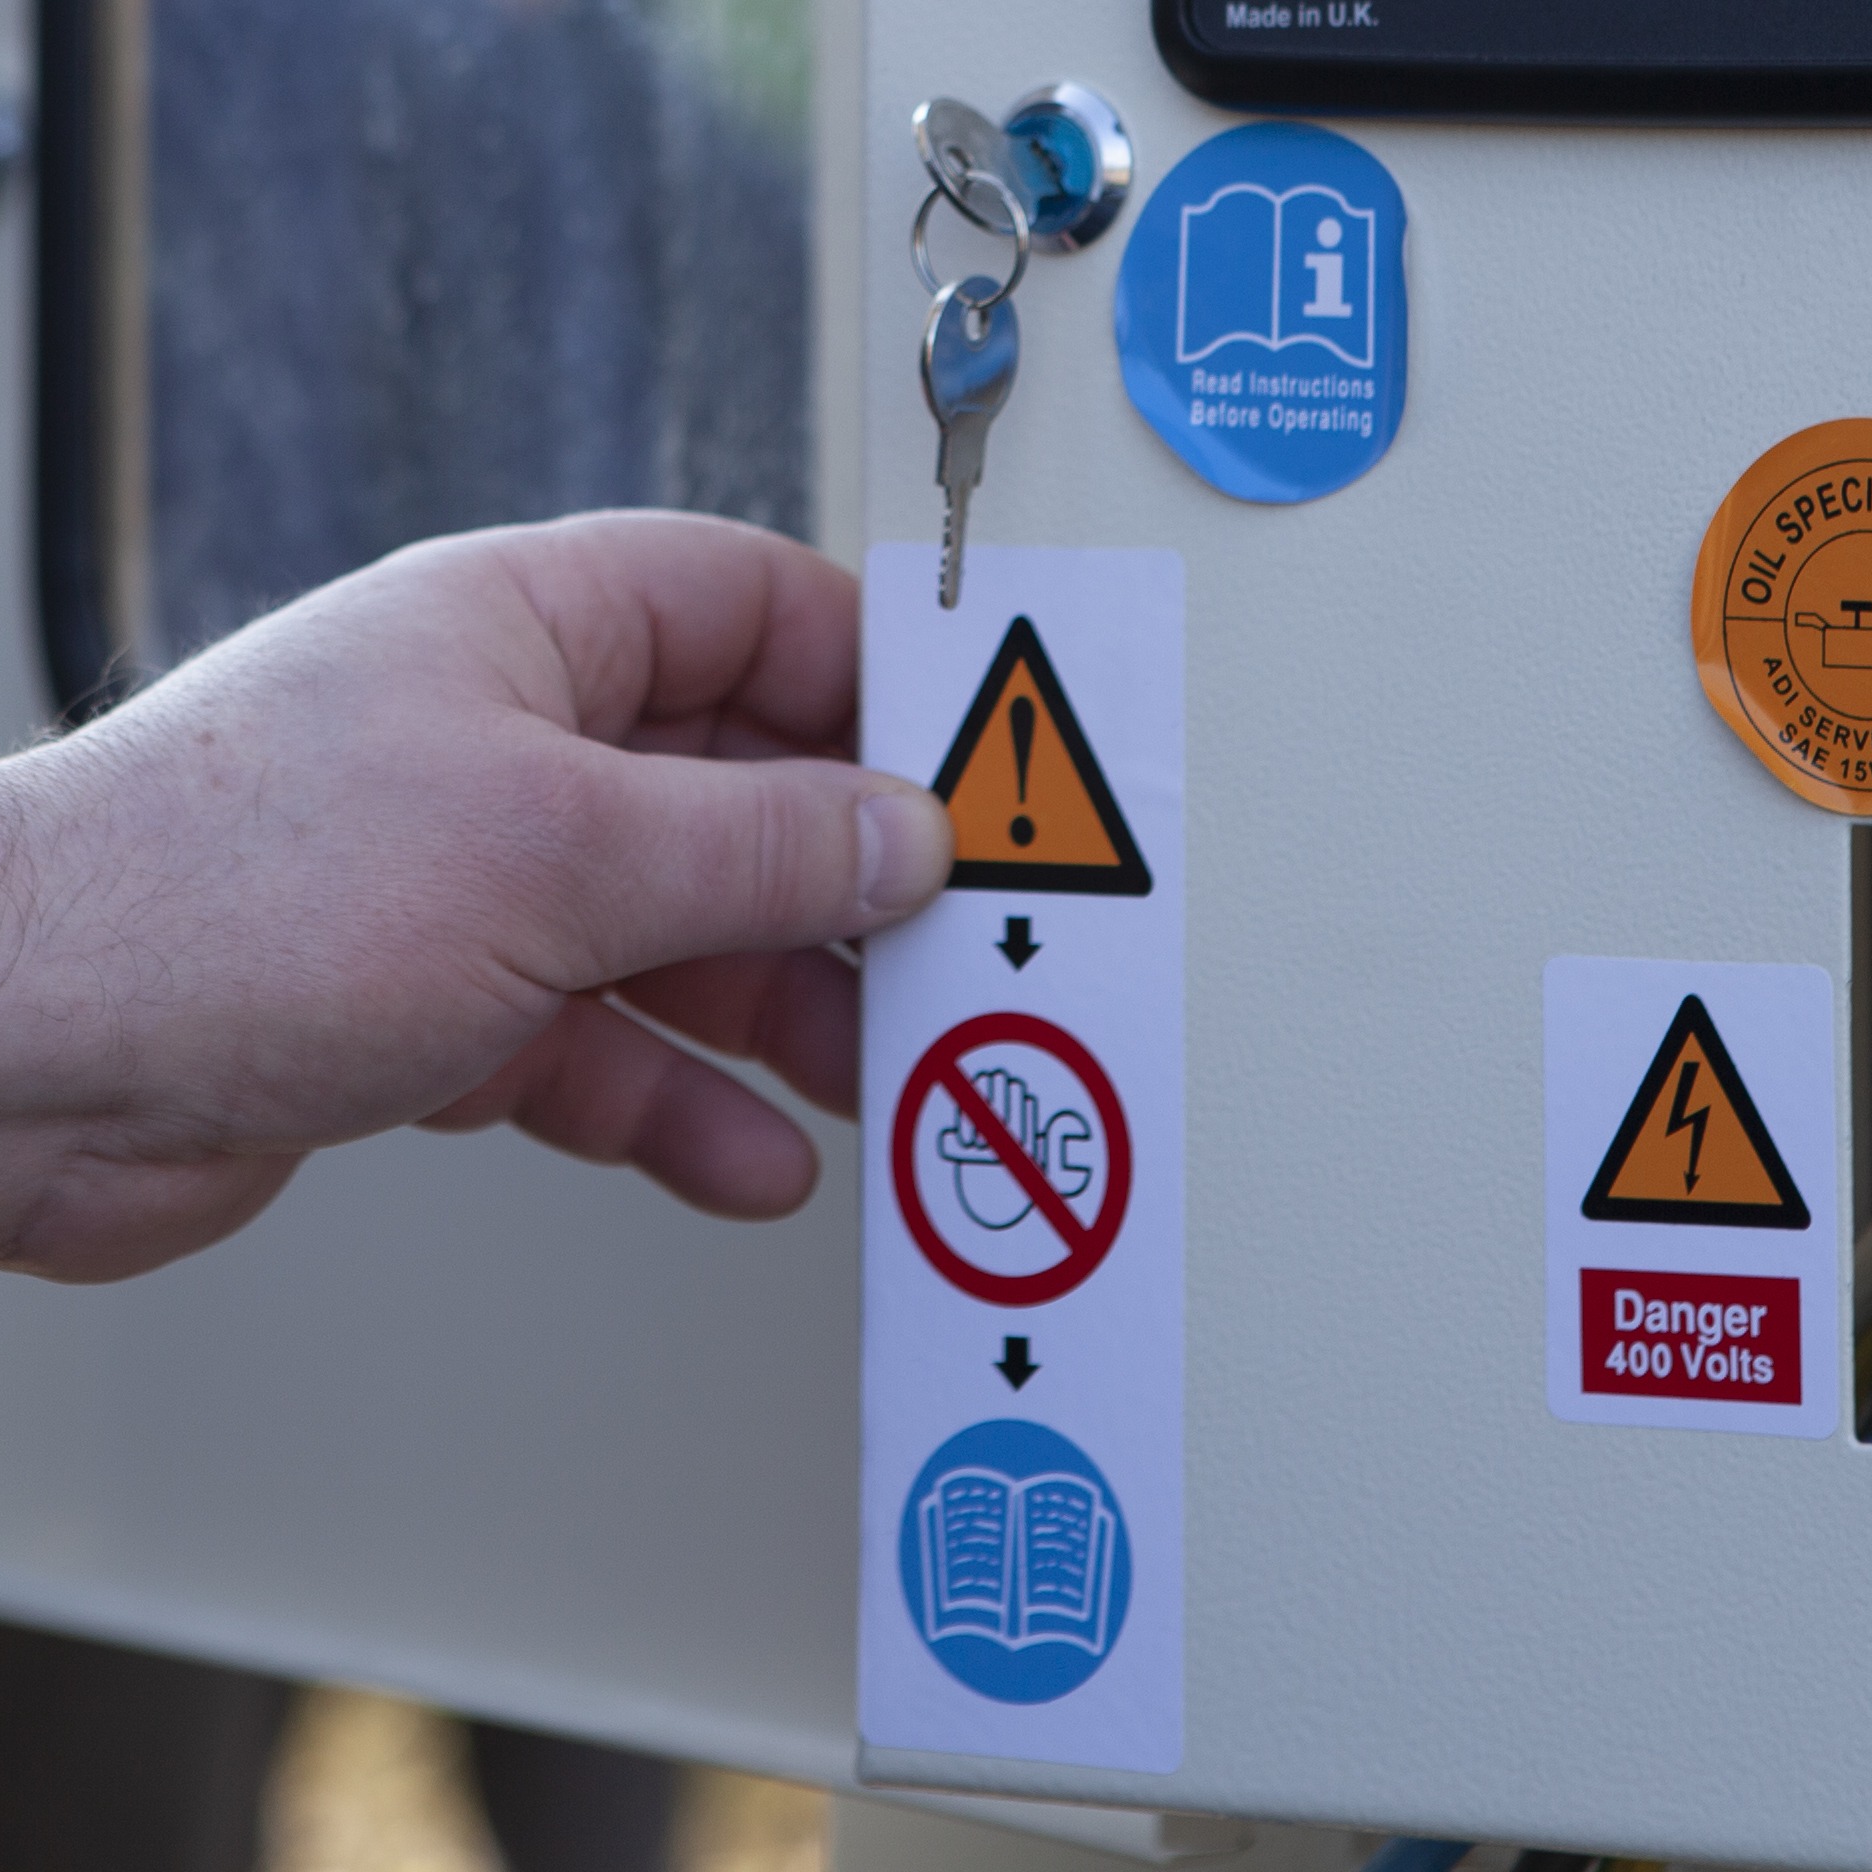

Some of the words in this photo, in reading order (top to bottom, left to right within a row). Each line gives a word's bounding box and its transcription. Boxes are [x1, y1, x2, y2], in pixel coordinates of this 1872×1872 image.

[1226, 4, 1292, 28] Made
[1298, 4, 1320, 26] in
[1327, 1, 1379, 27] U.K.
[1191, 368, 1242, 395] Read
[1250, 371, 1374, 399] Instructions
[1190, 400, 1261, 428] Before
[1268, 402, 1373, 438] Operating
[1741, 549, 1786, 605] OIL
[1763, 656, 1799, 706] ADI
[1779, 722, 1830, 770] SAE
[1614, 1288, 1768, 1346] Danger
[1605, 1340, 1673, 1377] 400
[1681, 1343, 1775, 1384] Volts
